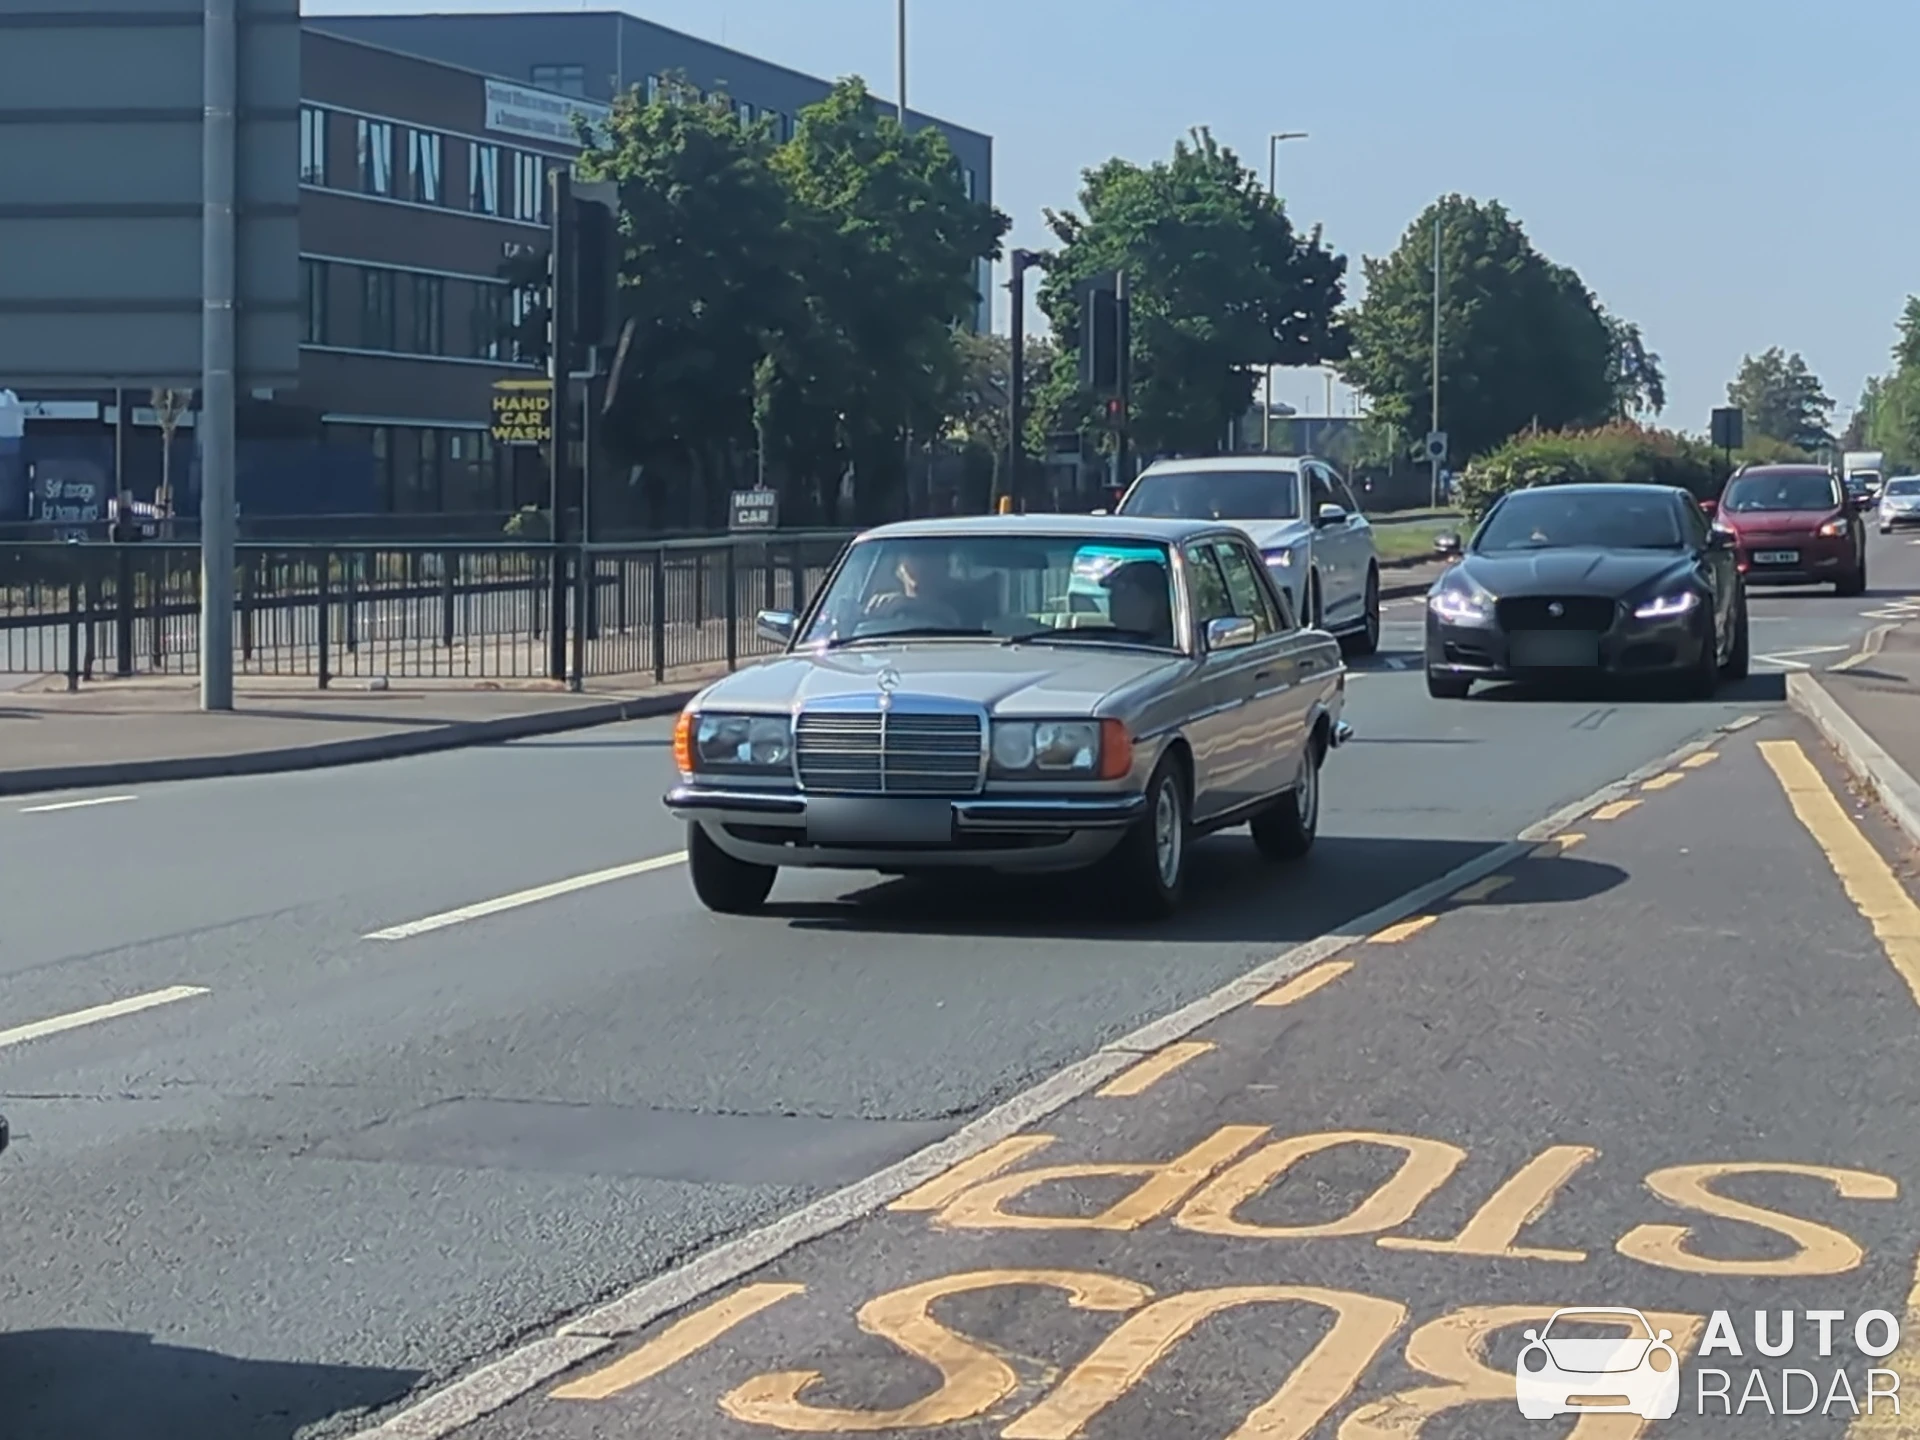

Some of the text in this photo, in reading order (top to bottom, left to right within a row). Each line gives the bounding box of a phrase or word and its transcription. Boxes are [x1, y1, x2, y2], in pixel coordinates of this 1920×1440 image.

[493, 397, 550, 411] HAND
[500, 412, 542, 425] CAR
[491, 426, 551, 440] WASH
[735, 493, 775, 507] HAND
[738, 510, 769, 523] CAR
[932, 1124, 1898, 1275] STOP
